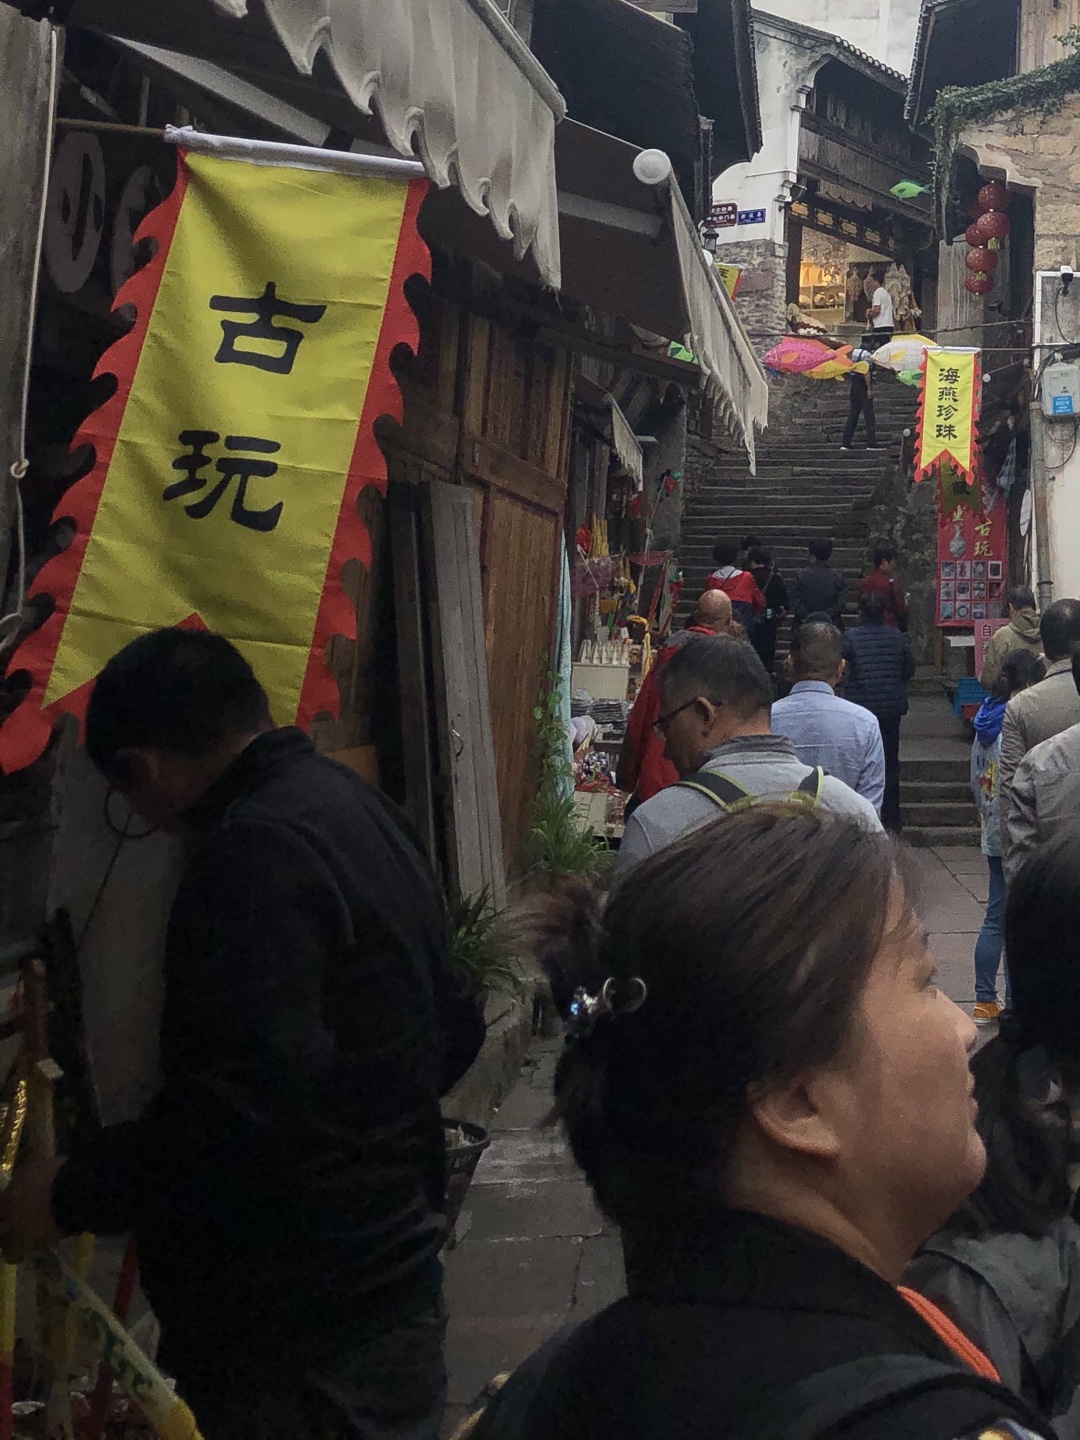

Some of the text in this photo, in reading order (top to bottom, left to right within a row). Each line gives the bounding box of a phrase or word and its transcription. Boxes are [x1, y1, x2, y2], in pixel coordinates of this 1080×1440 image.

[162, 280, 328, 533] 古玩
[935, 366, 962, 442] 海燕珍珠
